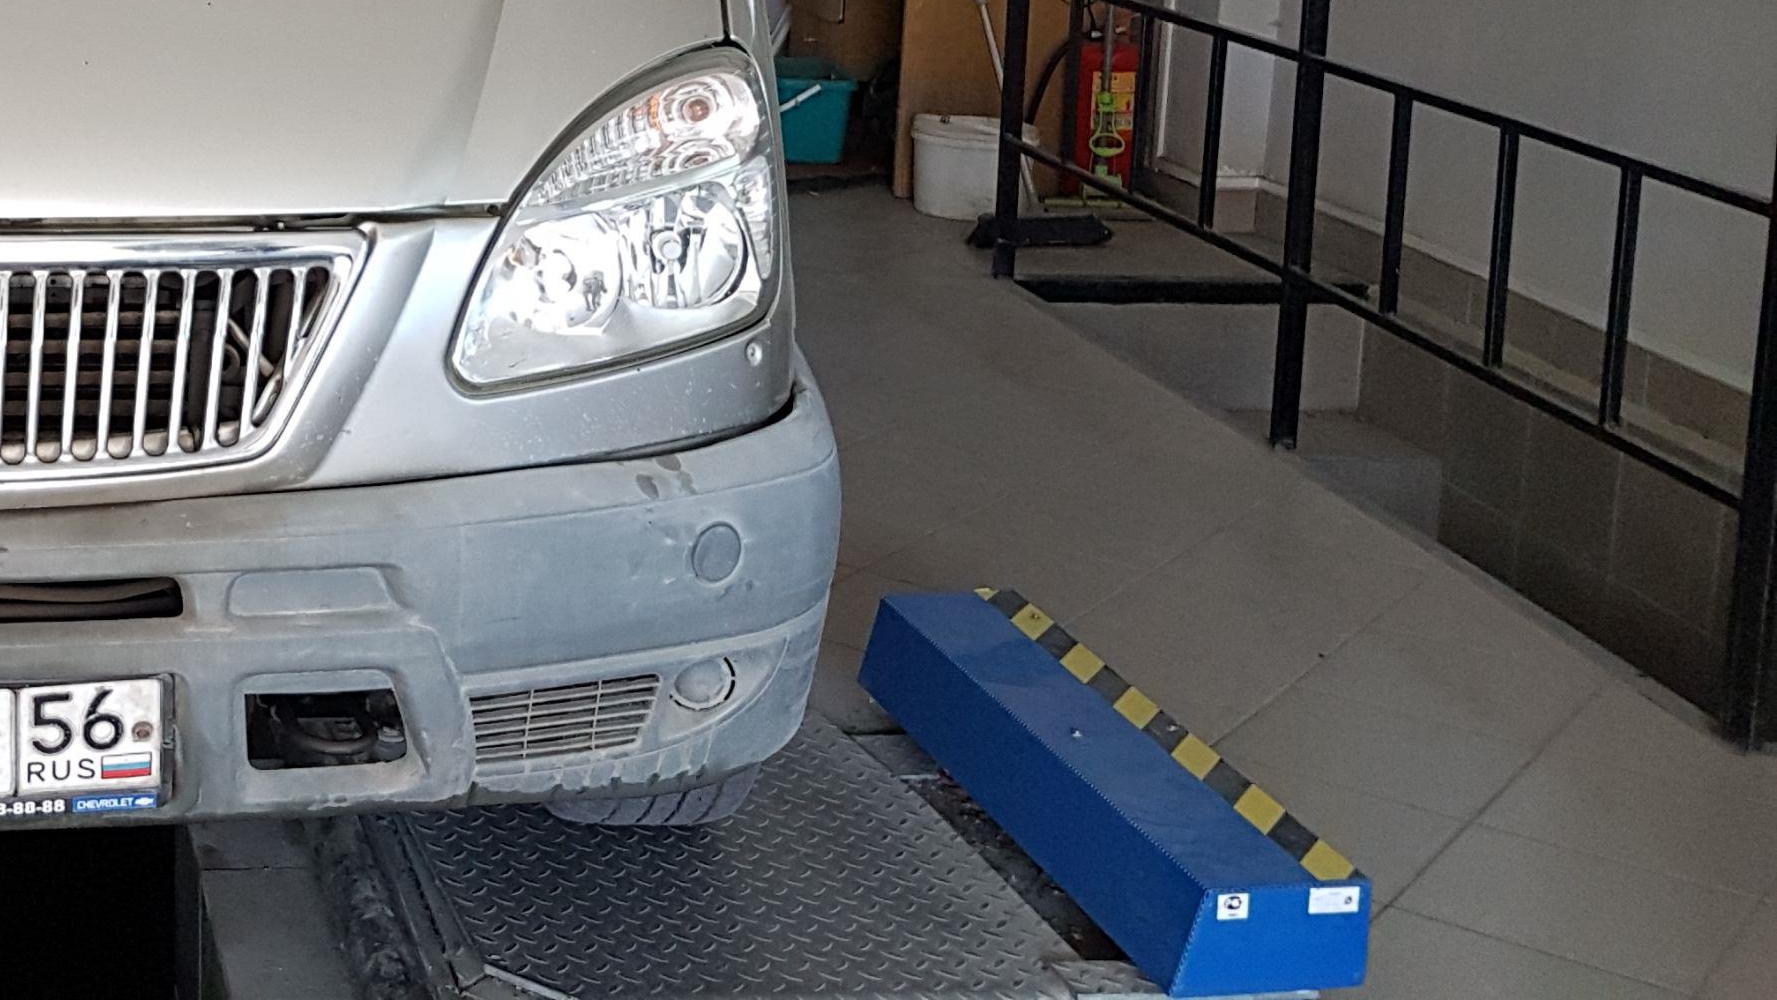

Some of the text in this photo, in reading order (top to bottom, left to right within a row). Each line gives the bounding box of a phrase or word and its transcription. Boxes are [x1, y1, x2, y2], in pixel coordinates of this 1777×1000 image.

[32, 688, 124, 755] 56
[26, 758, 96, 783] RUS
[76, 797, 134, 810] CHEVROLET
